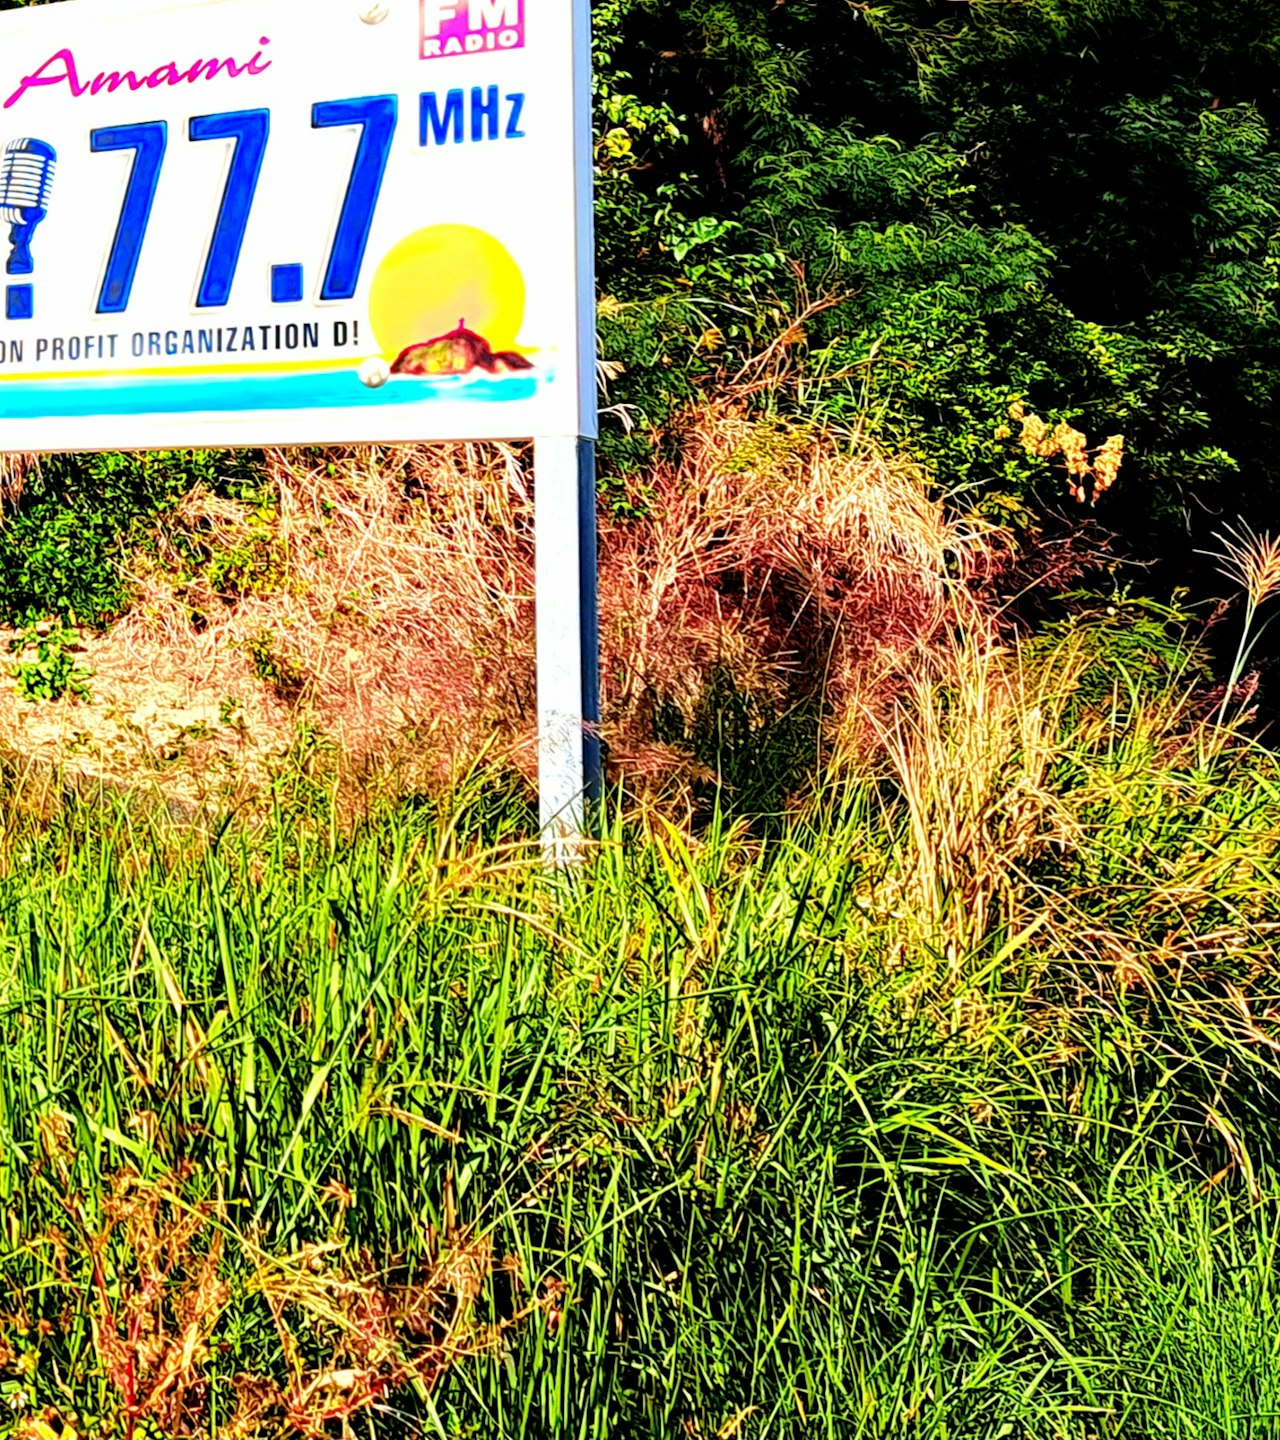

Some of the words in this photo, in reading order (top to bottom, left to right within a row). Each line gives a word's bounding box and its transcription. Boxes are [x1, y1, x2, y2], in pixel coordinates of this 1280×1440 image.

[423, 29, 519, 57] RADIO
[3, 36, 272, 109] Amami
[88, 93, 399, 313] 77.7
[418, 85, 525, 147] MHz
[35, 334, 119, 361] PROFIT
[131, 323, 320, 356] ORGANIZATION
[333, 320, 360, 348] D!
